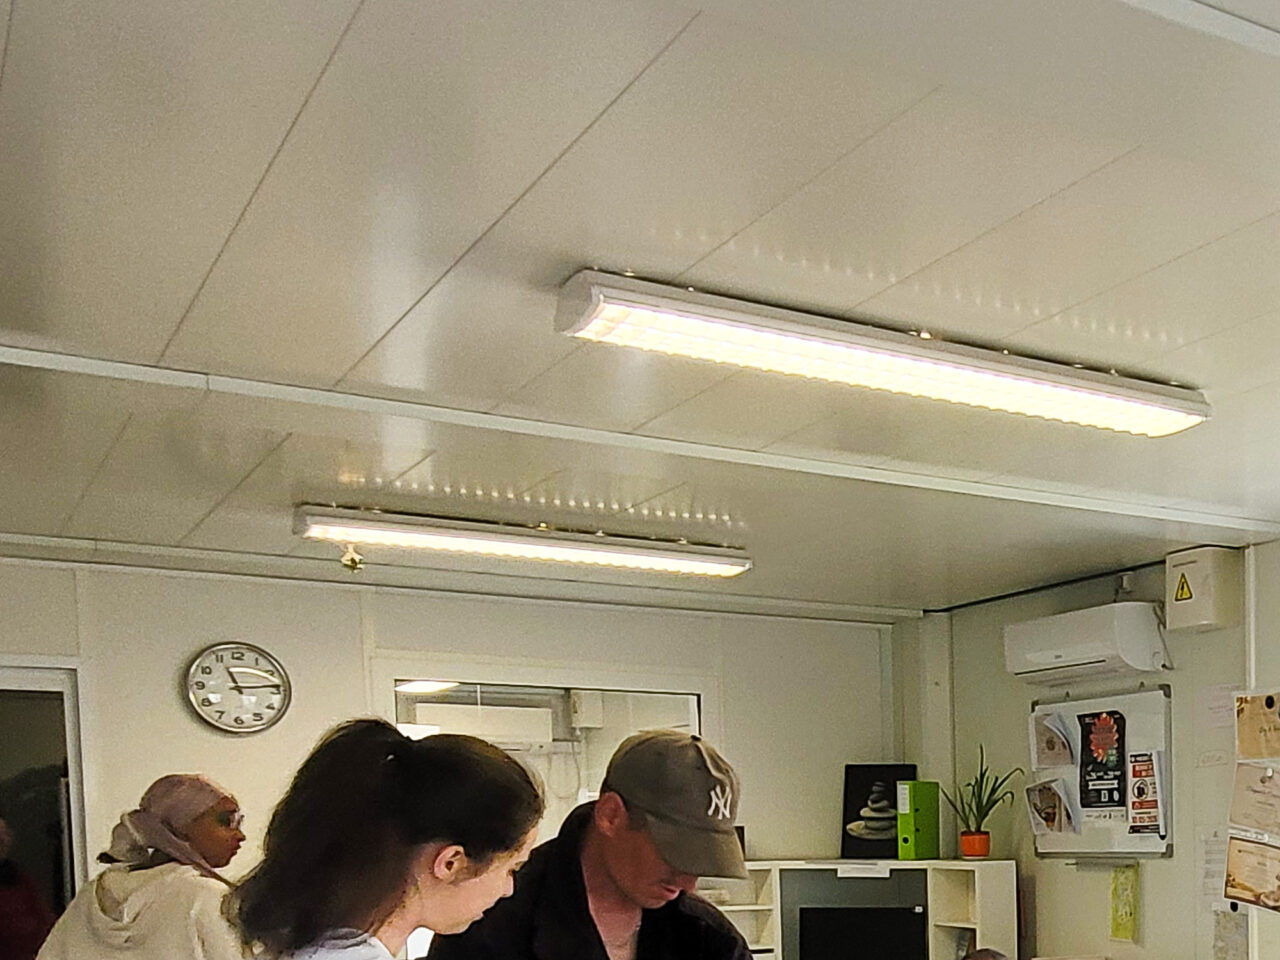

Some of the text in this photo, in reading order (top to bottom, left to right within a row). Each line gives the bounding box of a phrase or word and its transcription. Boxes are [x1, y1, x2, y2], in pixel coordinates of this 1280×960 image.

[215, 654, 224, 664] 11
[231, 651, 245, 661] 12
[201, 665, 212, 675] 10
[195, 680, 206, 690] 9
[201, 697, 212, 707] 8
[265, 702, 276, 710] 4
[214, 710, 226, 720] 7
[252, 712, 264, 722] 5
[233, 716, 245, 725] 6
[707, 784, 733, 820] NY
